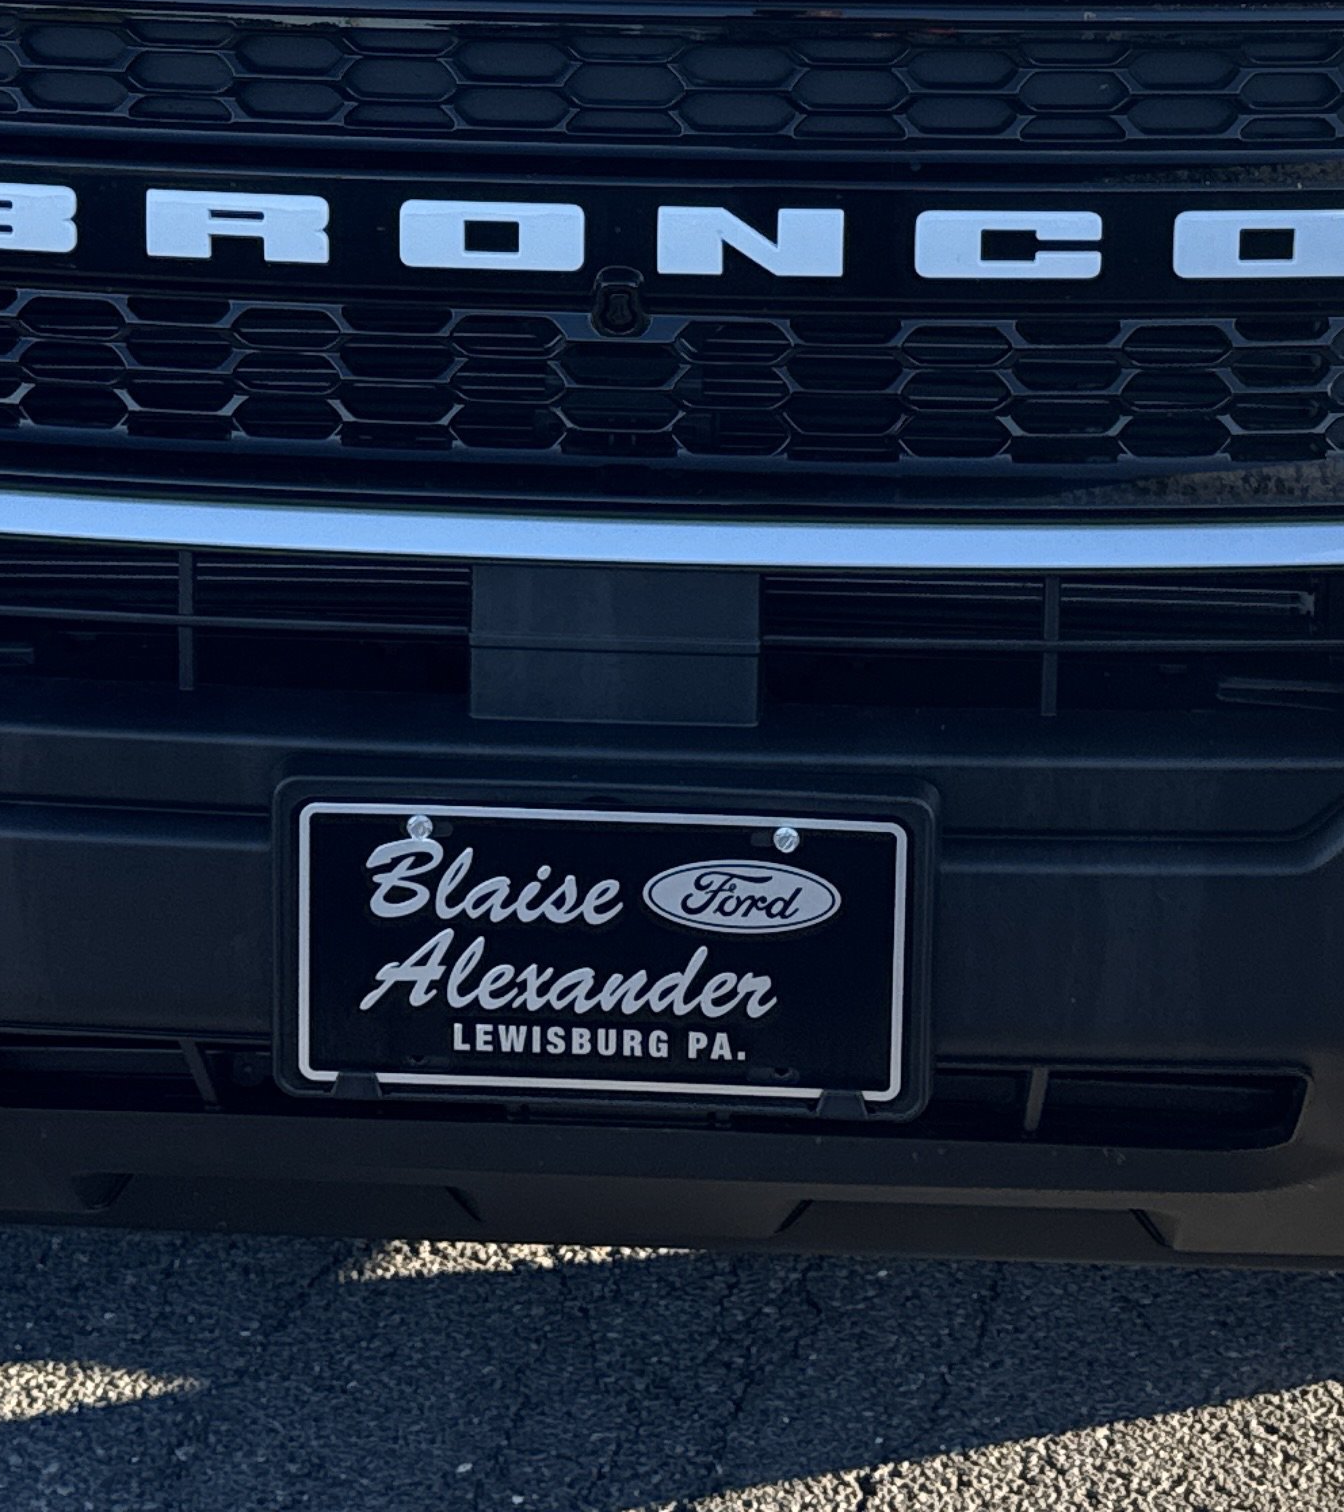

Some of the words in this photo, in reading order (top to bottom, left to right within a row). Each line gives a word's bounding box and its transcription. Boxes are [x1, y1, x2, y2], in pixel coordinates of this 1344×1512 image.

[365, 837, 623, 925] Blaise
[680, 870, 803, 919] Ford
[359, 928, 778, 1019] Alexander
[452, 1022, 669, 1059] LEWISBURG
[687, 1031, 747, 1061] PA.
